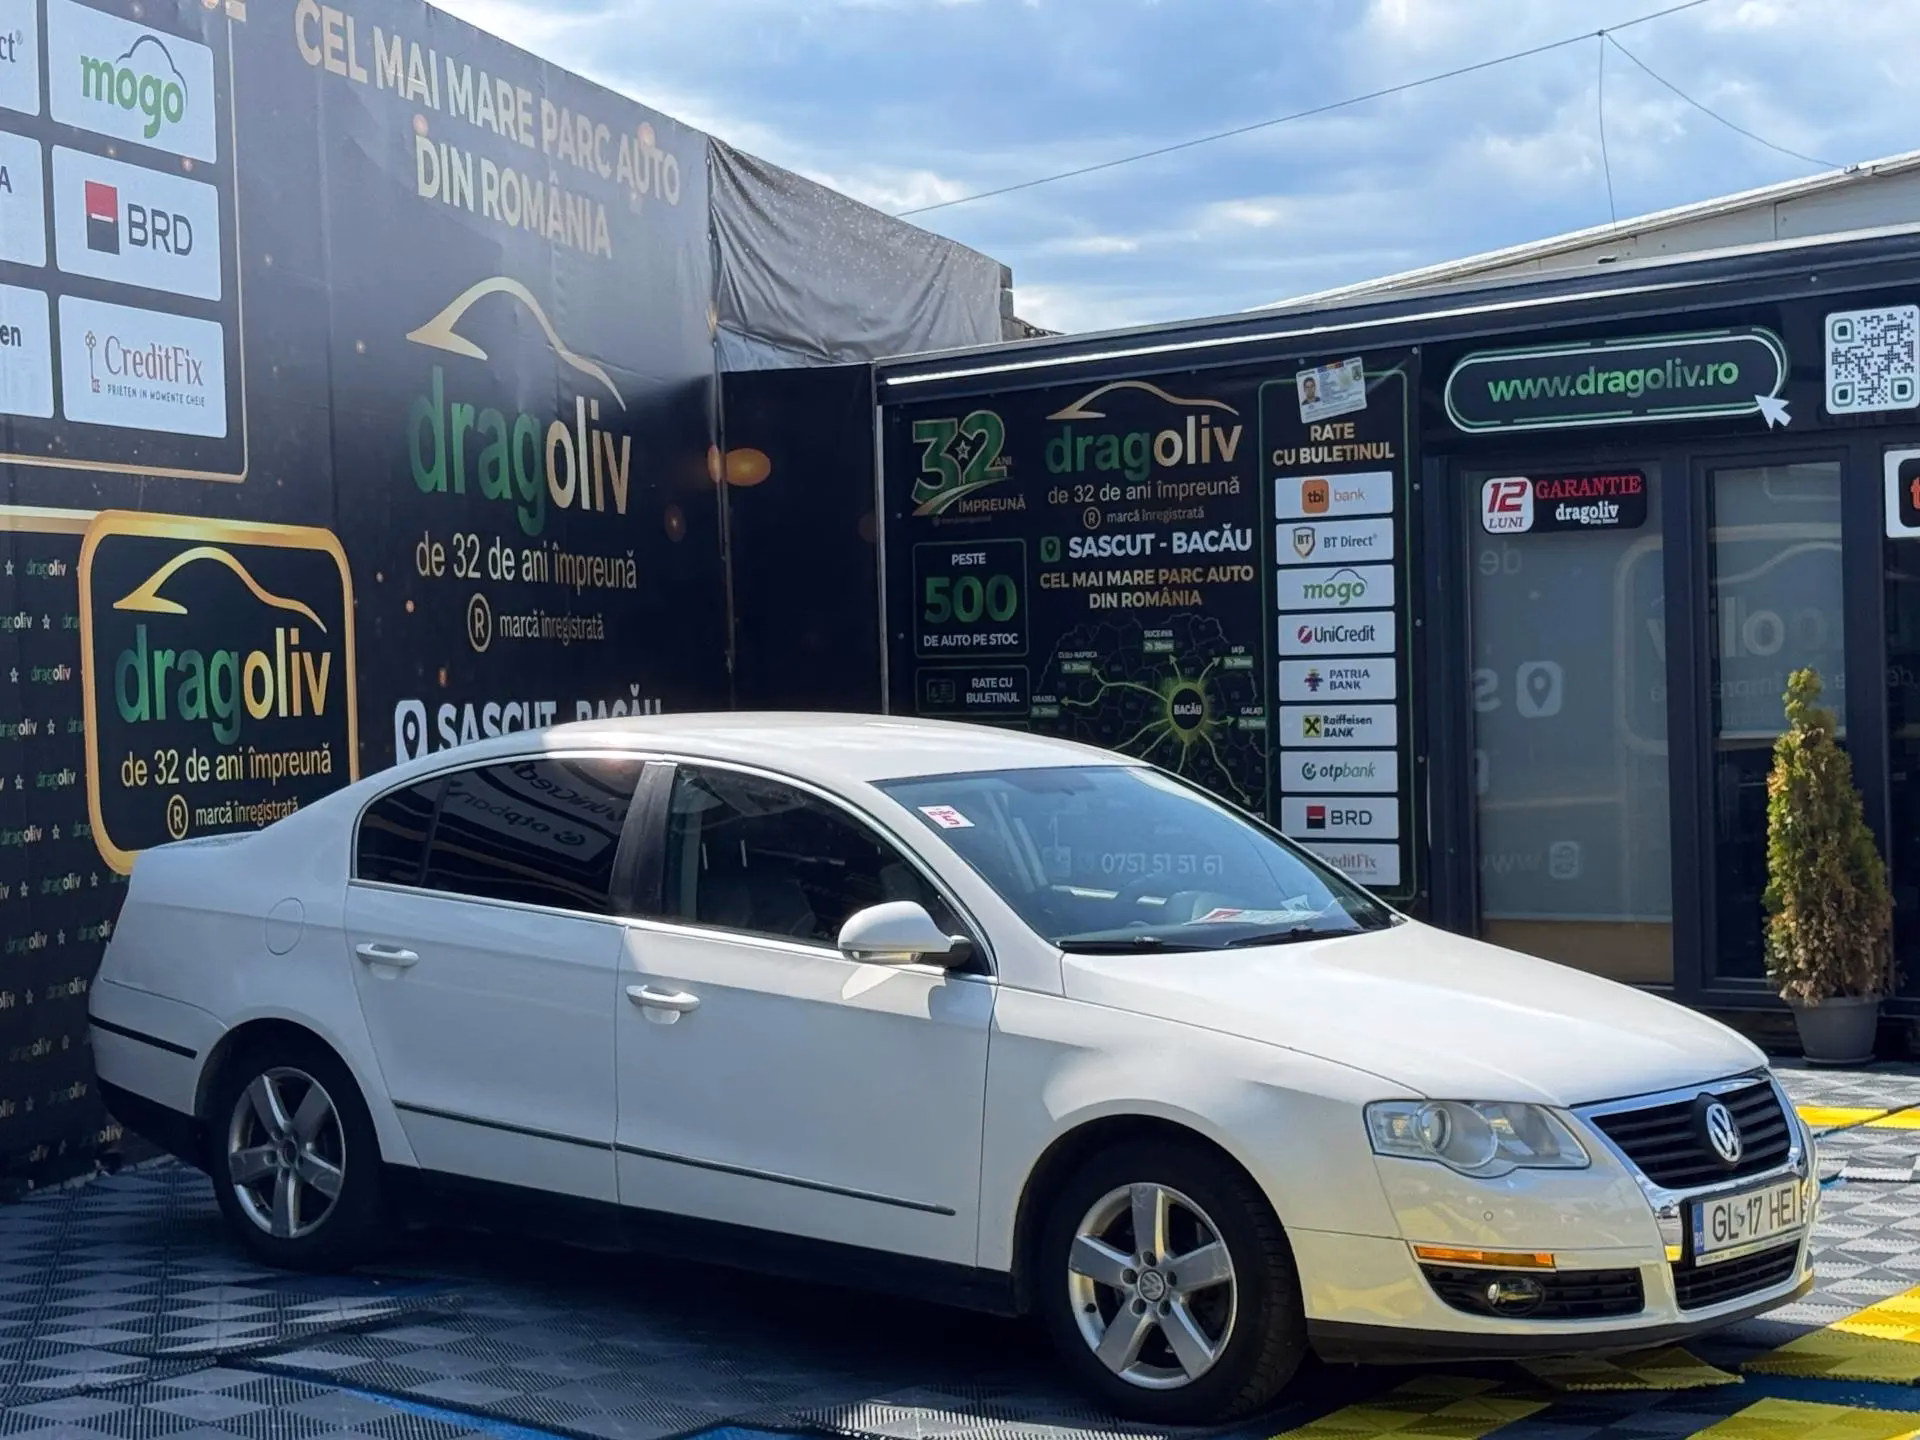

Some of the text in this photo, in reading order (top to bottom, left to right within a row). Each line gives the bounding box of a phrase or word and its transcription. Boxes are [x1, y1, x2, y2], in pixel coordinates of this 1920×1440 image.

[81, 55, 184, 139] mogo
[295, 0, 680, 206] CEL MAI MARE PARC AUTO
[415, 134, 612, 259] DIN ROMÂNIA
[128, 203, 193, 256] BRD
[105, 335, 204, 387] CreditFix
[1488, 357, 1740, 403] www.dragoliv.ro
[1310, 422, 1355, 442] RATE
[409, 364, 632, 537] dragoliv
[911, 409, 1007, 505] 32
[1045, 415, 1243, 482] dragoliv
[1272, 442, 1396, 466] CU BULETINUL
[1048, 475, 1241, 504] de 32 de ani împreună
[1306, 488, 1366, 505] tbi bank
[1488, 480, 1528, 514] 12
[1535, 475, 1643, 500] GARANTIE
[1106, 508, 1140, 523] marcă
[1141, 506, 1205, 524] înregistrată
[1488, 516, 1524, 530] LUNI
[1555, 500, 1620, 524] dragoliv
[1069, 533, 1155, 559] SASCUT
[1172, 523, 1253, 554] BACĂU
[1323, 536, 1338, 549] BT
[26, 559, 67, 579] dragoliv
[415, 530, 638, 597] de 32 de ani împreună
[951, 553, 986, 566] PESTE
[1040, 565, 1254, 589] CEL MAI MARE PARC AUTO
[924, 574, 1018, 624] 500
[1089, 588, 1203, 609] DIN ROMÂNIA
[1303, 581, 1366, 606] mogo
[500, 609, 540, 639] marcă
[540, 610, 605, 647] înregistrată
[923, 632, 1019, 647] DE AUTO PE STOC
[1314, 625, 1376, 644] UniCredit
[114, 623, 332, 746] dragoliv
[971, 676, 1014, 689] RATE CU
[1329, 669, 1371, 680] PATRIA
[1329, 680, 1362, 691] BANK
[966, 690, 1020, 704] BULETINUL
[1323, 714, 1373, 726] Raiffeisen
[1323, 726, 1355, 738] BANK
[121, 742, 332, 788] de 32 de ani împreună
[1319, 762, 1376, 782] otpbank
[195, 801, 234, 827] marcă
[1330, 810, 1373, 826] BRD
[1712, 1202, 1740, 1243] GL
[1746, 1195, 1763, 1236] 17
